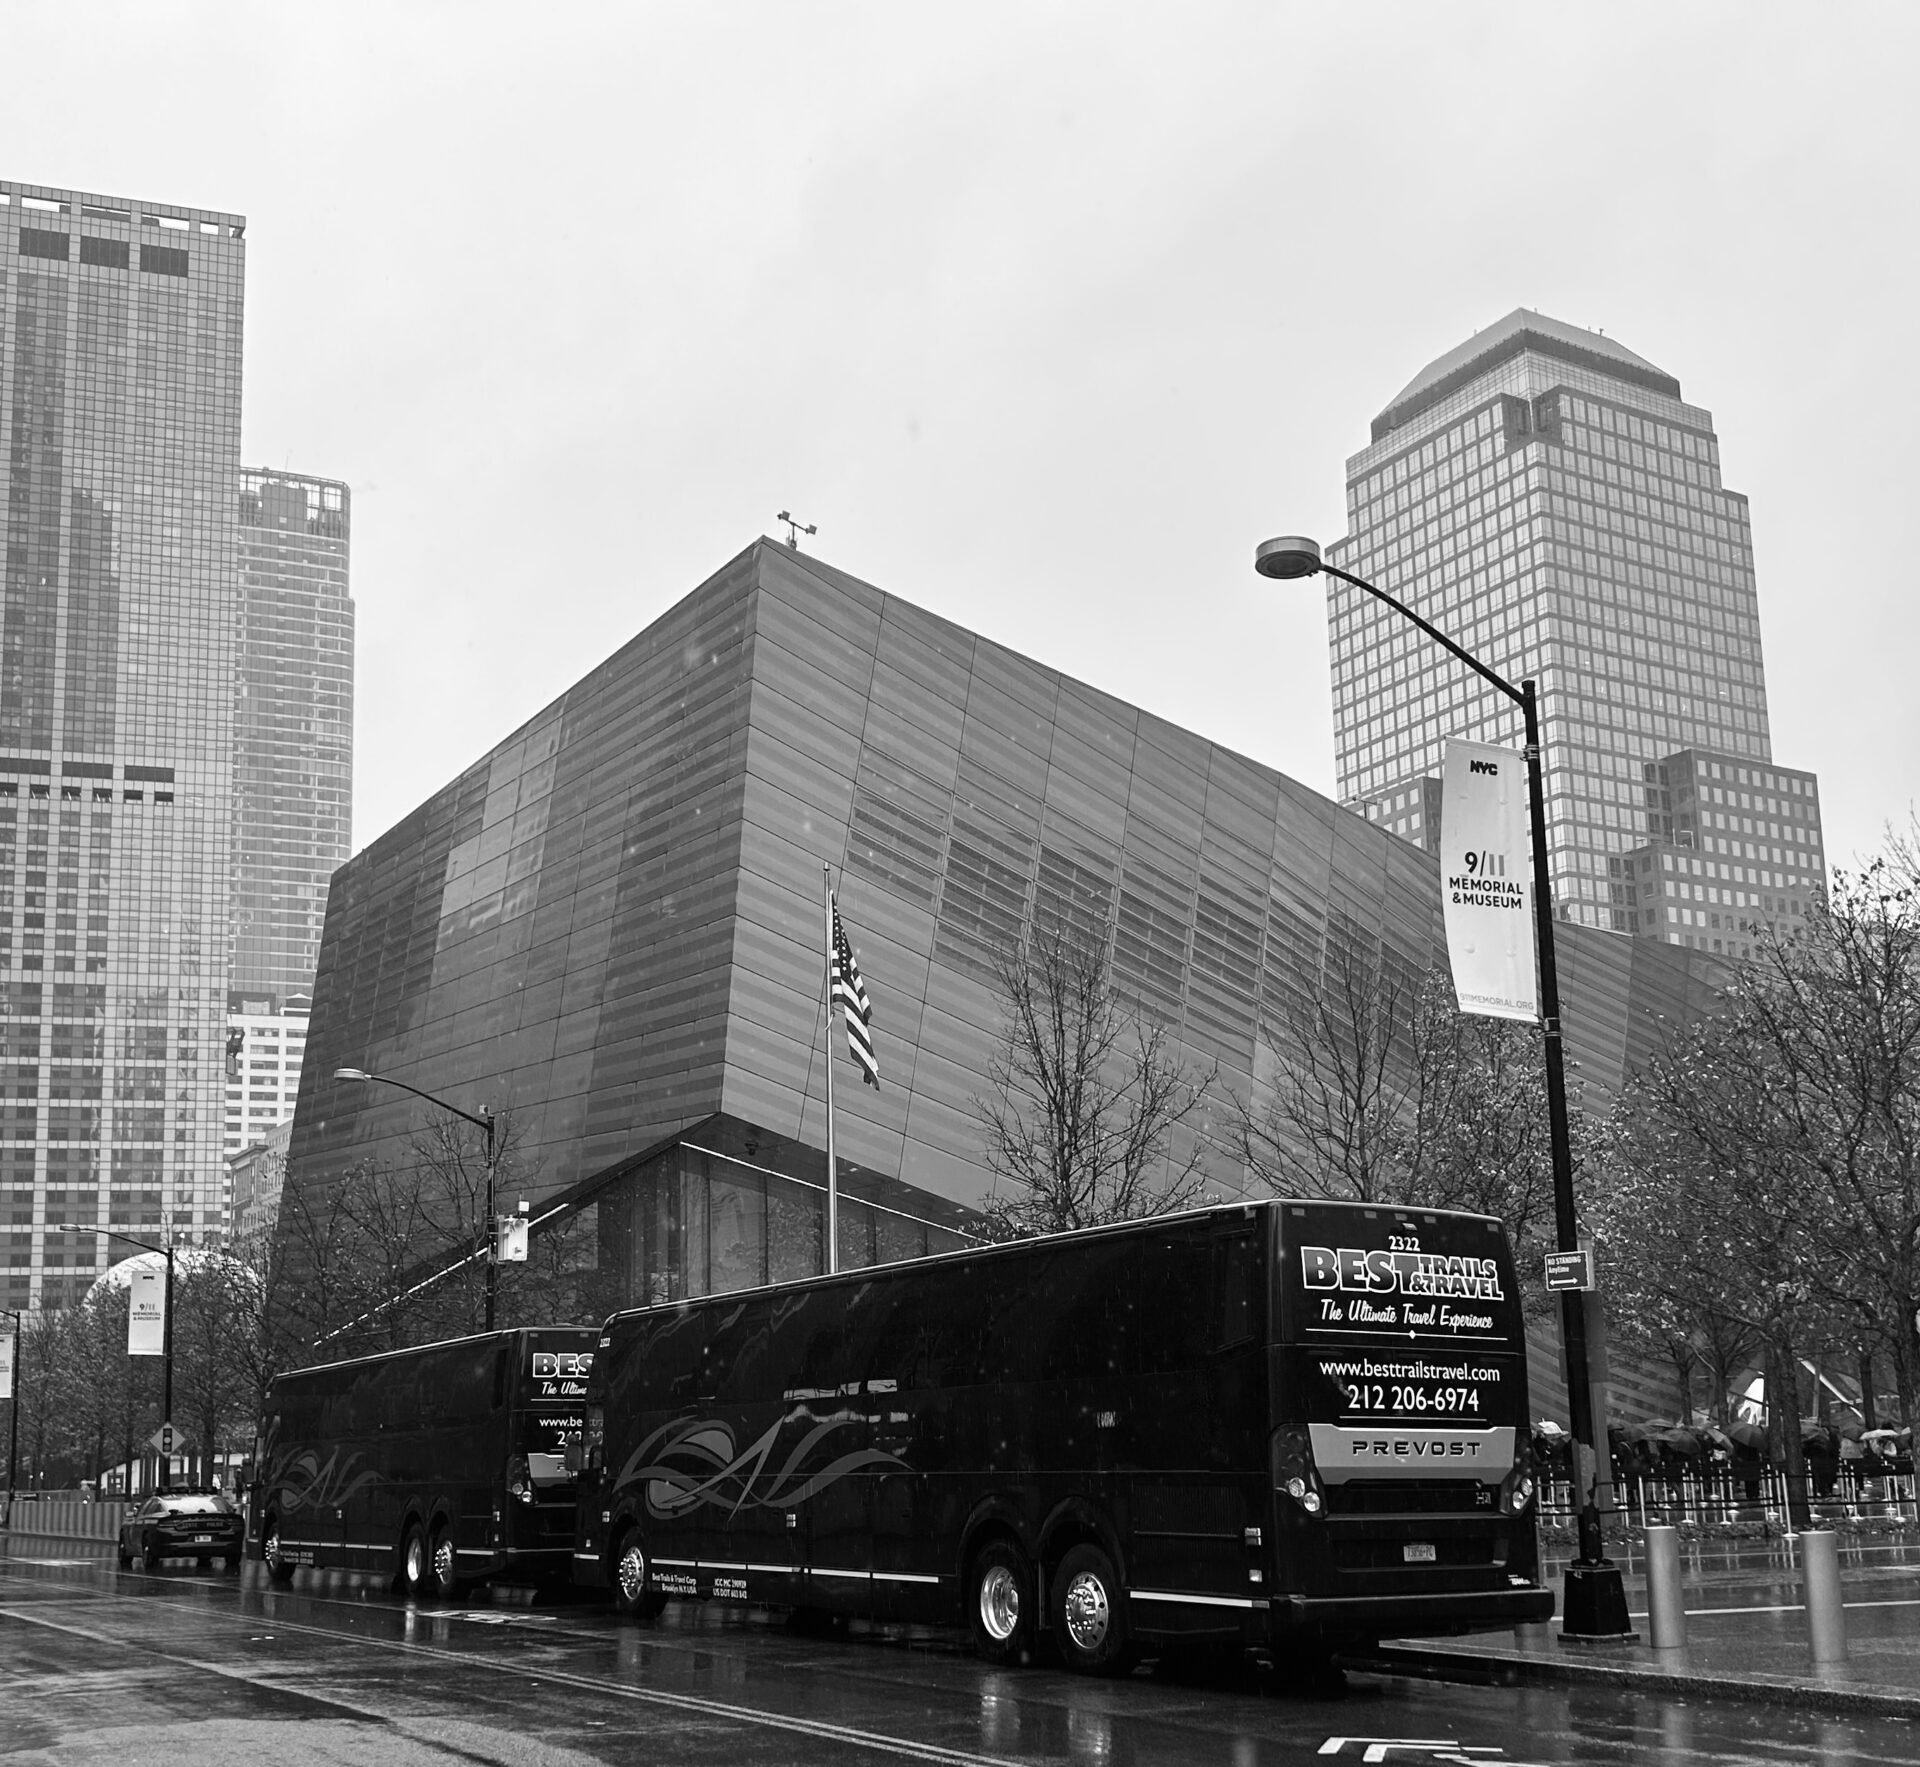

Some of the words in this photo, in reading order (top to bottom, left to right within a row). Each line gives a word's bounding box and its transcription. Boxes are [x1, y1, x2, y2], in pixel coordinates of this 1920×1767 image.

[1470, 760, 1498, 776] NYC
[1464, 851, 1505, 878] 9/11
[1449, 877, 1524, 895] MEMORIAL
[1388, 1235, 1421, 1251] 2322
[1547, 1258, 1556, 1266] NO
[1556, 1255, 1582, 1265] STANDING
[1301, 1246, 1421, 1295] BEST
[1419, 1254, 1498, 1280] TRAILS
[1321, 1299, 1343, 1320] The
[1349, 1300, 1397, 1323] Ultimate
[1402, 1303, 1436, 1325] Travel
[1440, 1305, 1493, 1333] Experience
[1319, 1358, 1500, 1381] www.besttrailstravel.com
[542, 1382, 557, 1395] The
[1348, 1384, 1386, 1409] 212
[1391, 1385, 1480, 1412] 206-6974
[1352, 1440, 1482, 1456] PREVOST
